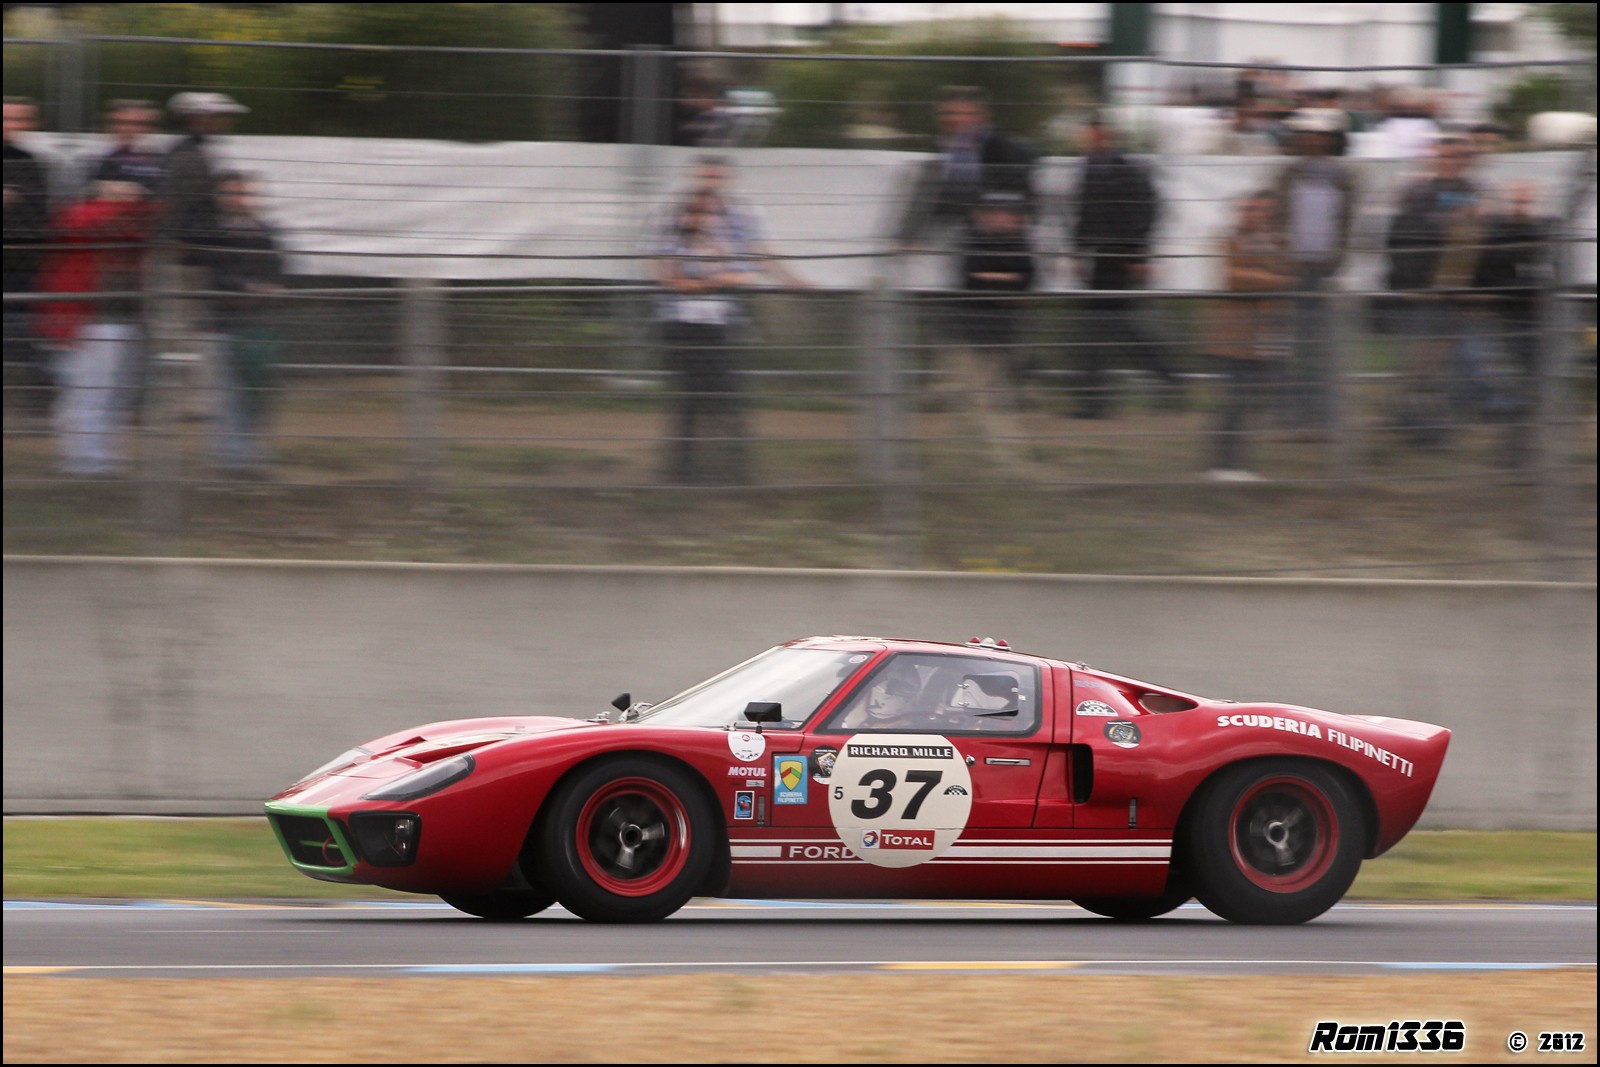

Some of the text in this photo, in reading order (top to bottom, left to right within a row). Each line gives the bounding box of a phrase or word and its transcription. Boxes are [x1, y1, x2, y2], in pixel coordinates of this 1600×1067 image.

[850, 746, 952, 757] RICHARD MILLE
[1217, 714, 1414, 778] SCUDERIA FILIPINETTI
[728, 766, 767, 777] MOTUL
[833, 786, 844, 800] 5
[850, 768, 943, 820] 37
[788, 845, 858, 859] FORD
